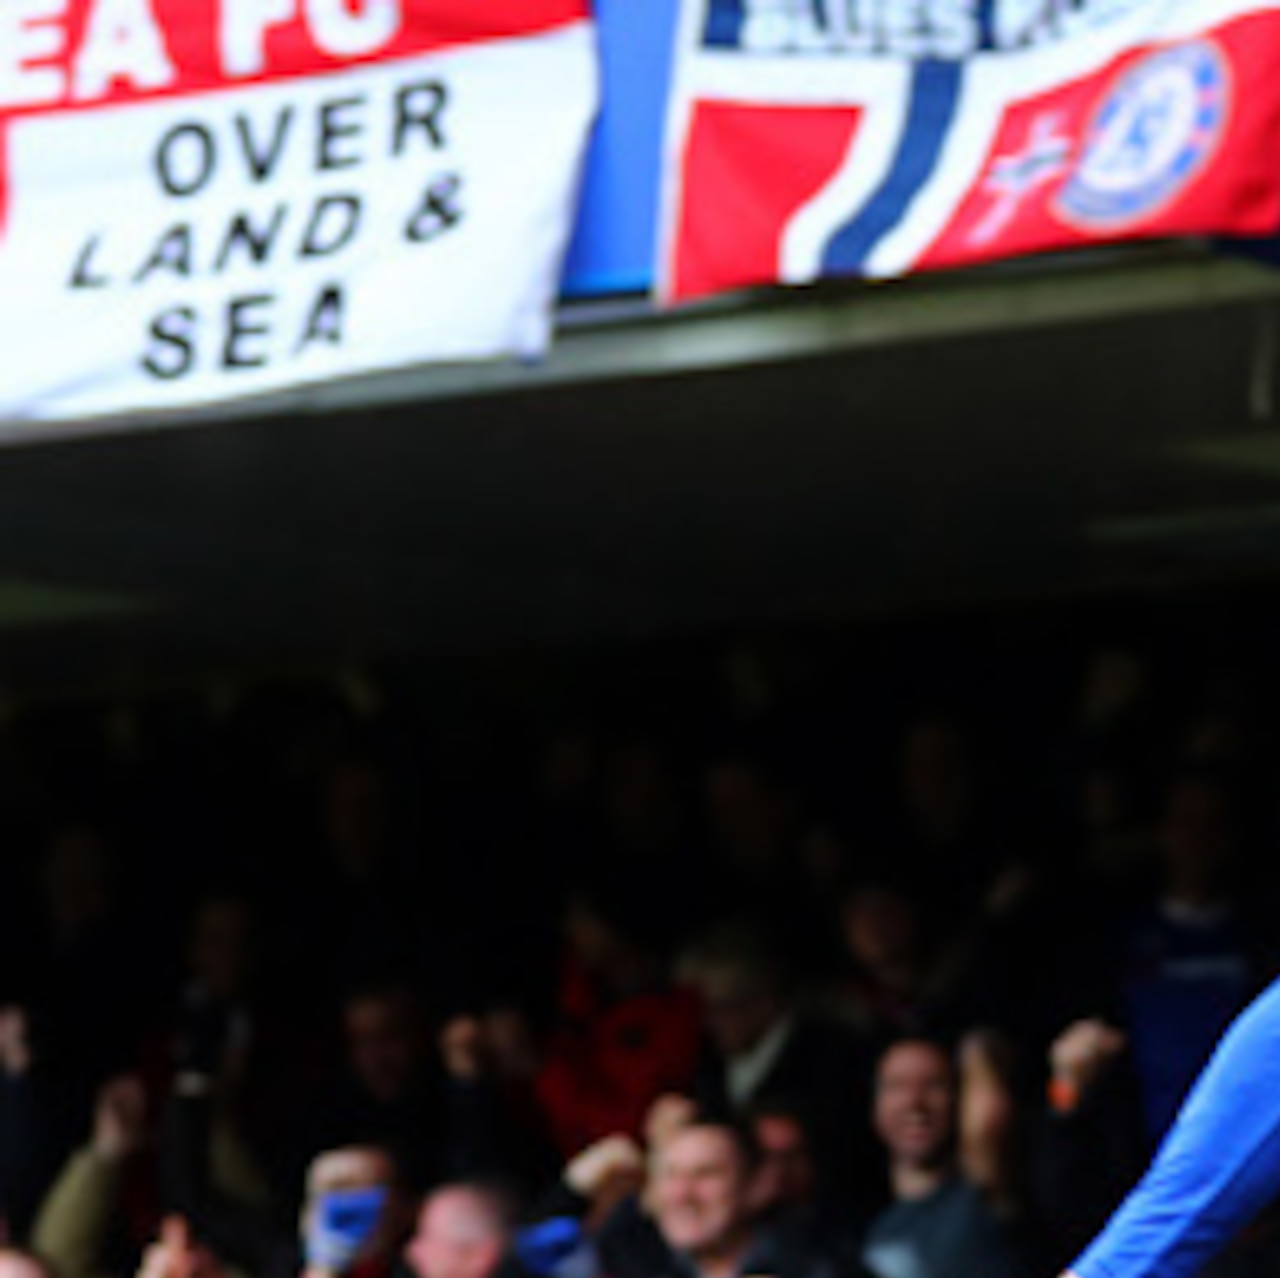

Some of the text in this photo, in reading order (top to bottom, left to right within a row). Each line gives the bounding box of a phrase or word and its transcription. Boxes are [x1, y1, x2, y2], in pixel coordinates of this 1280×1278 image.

[153, 78, 452, 198] OVER
[66, 173, 464, 290] LAND &
[140, 283, 345, 381] SEA
